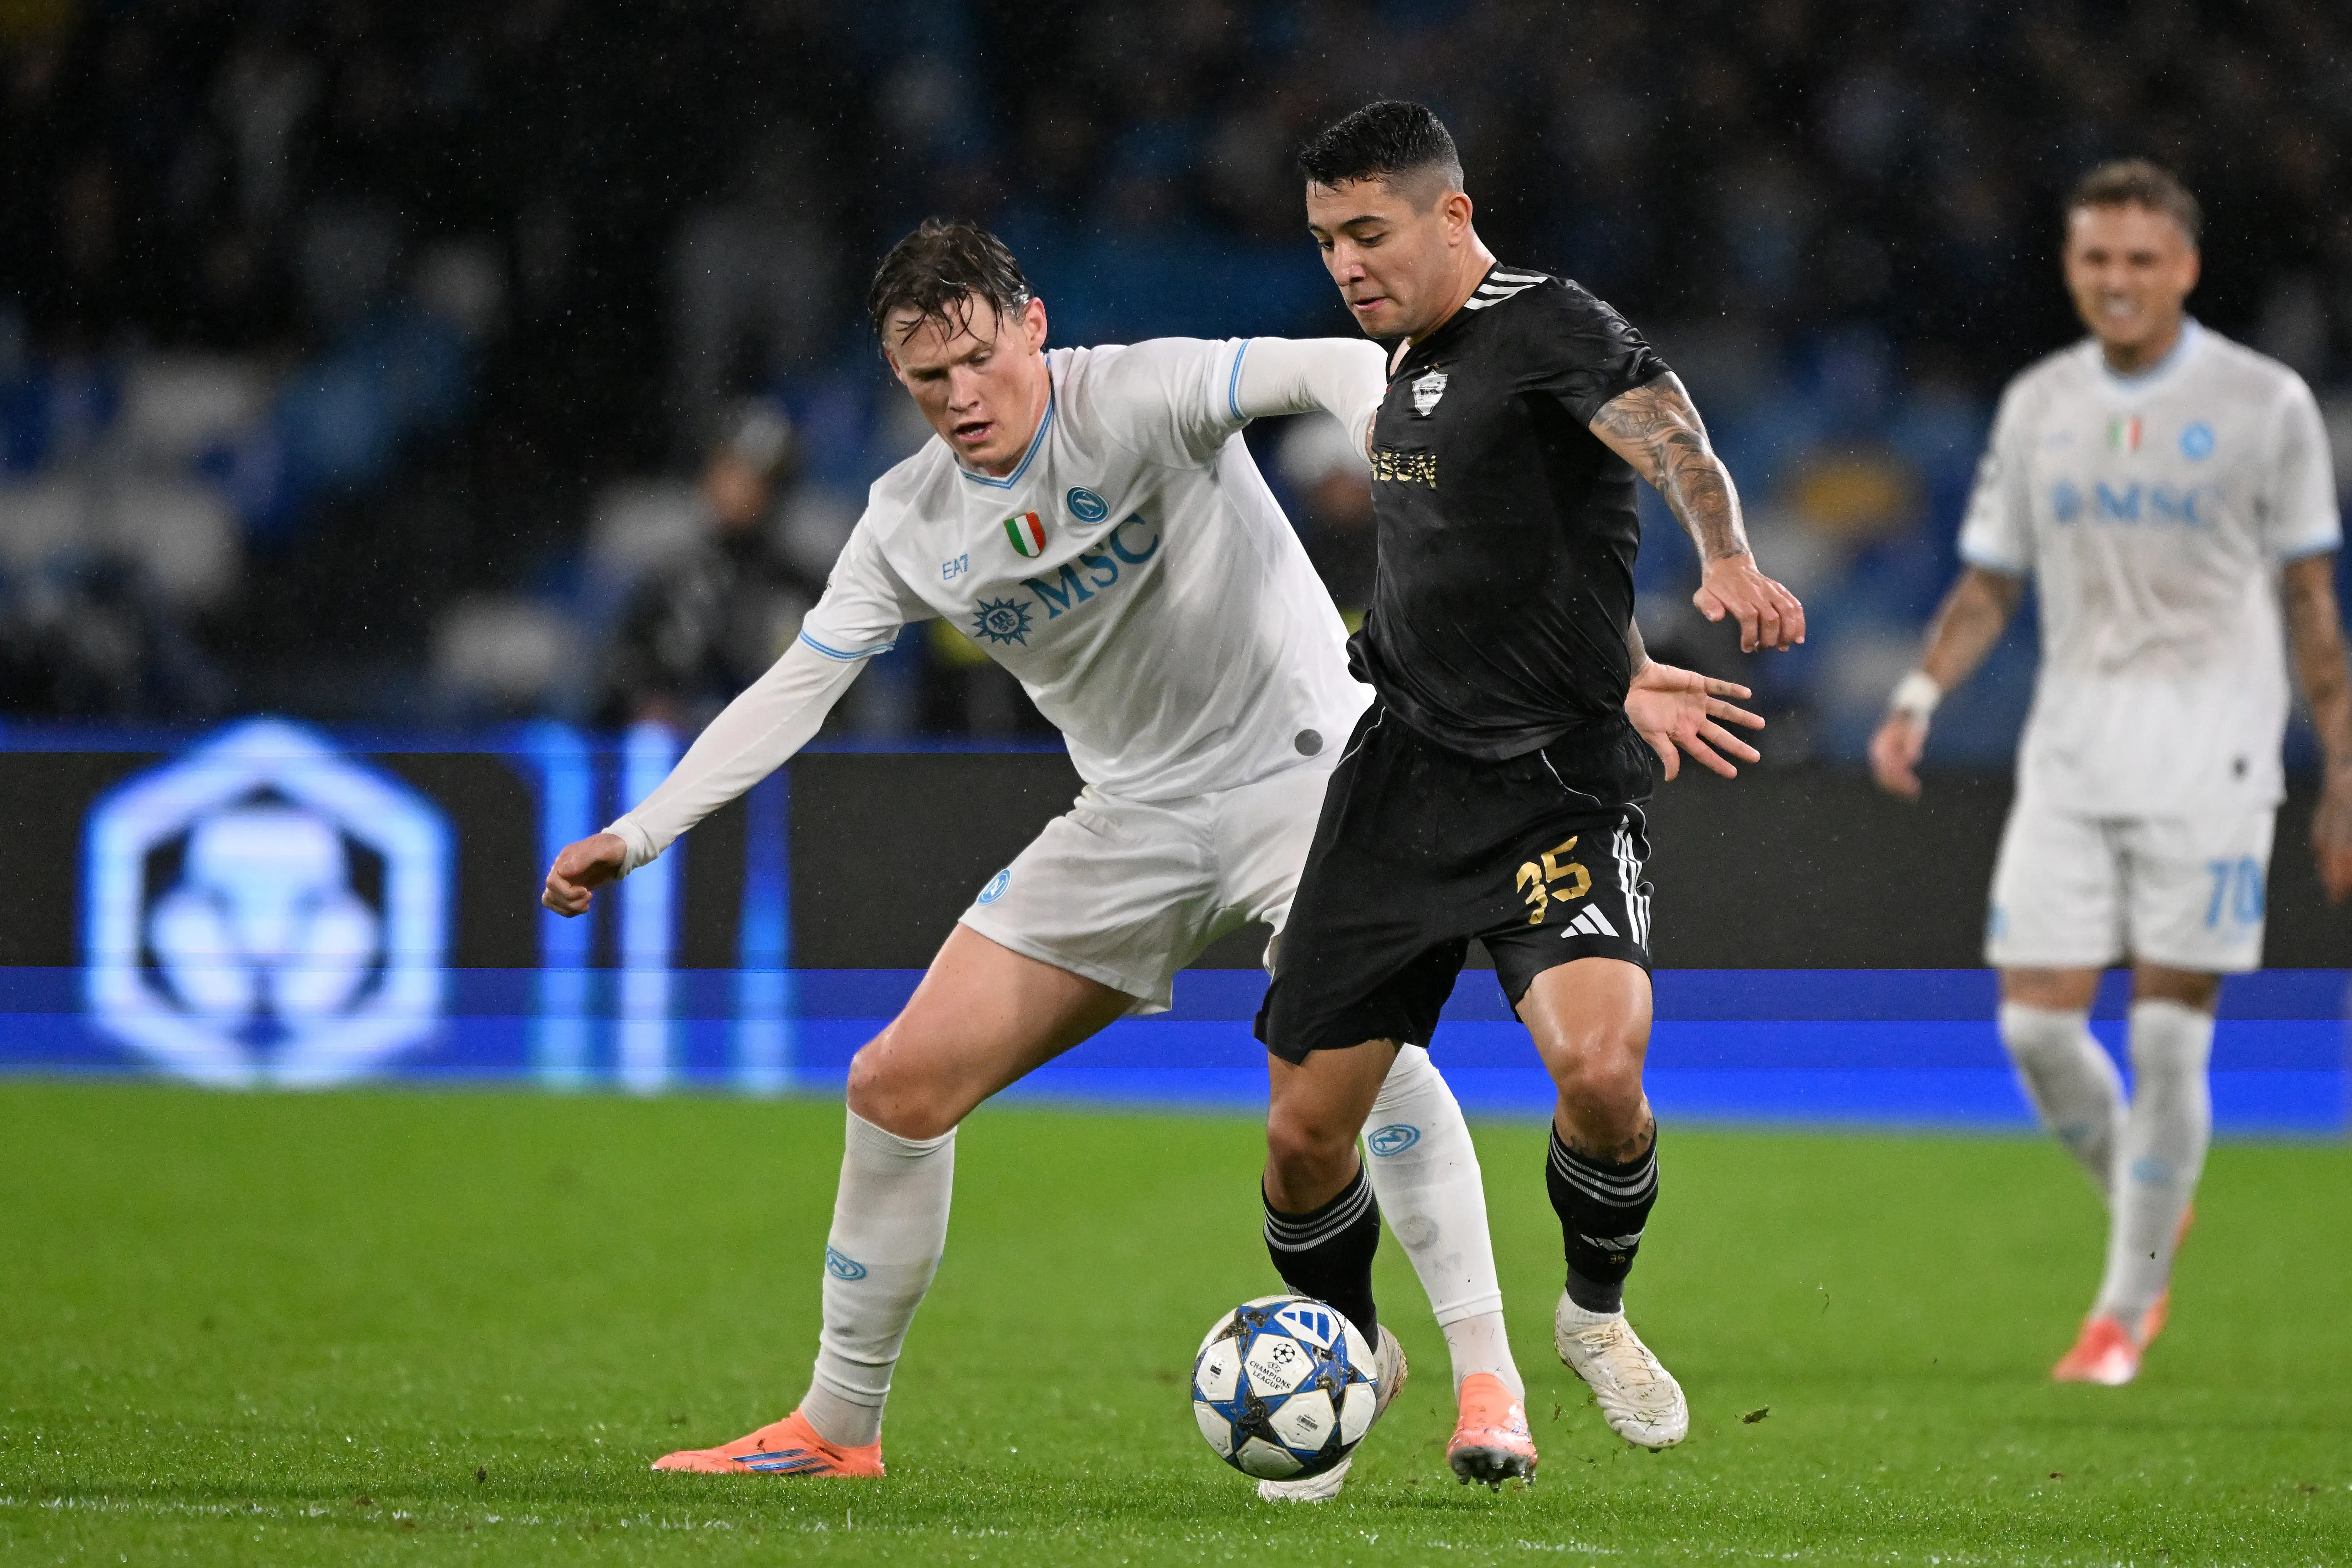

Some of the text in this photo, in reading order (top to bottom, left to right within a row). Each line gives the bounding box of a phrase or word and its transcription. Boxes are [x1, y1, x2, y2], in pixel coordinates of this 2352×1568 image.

[942, 554, 968, 580] EA7
[1020, 513, 1158, 619] MSC
[1516, 836, 1592, 924] 35
[2204, 856, 2266, 929] 70
[1610, 1254, 1625, 1264] 35
[1250, 1361, 1291, 1389] CHAMPIONS
